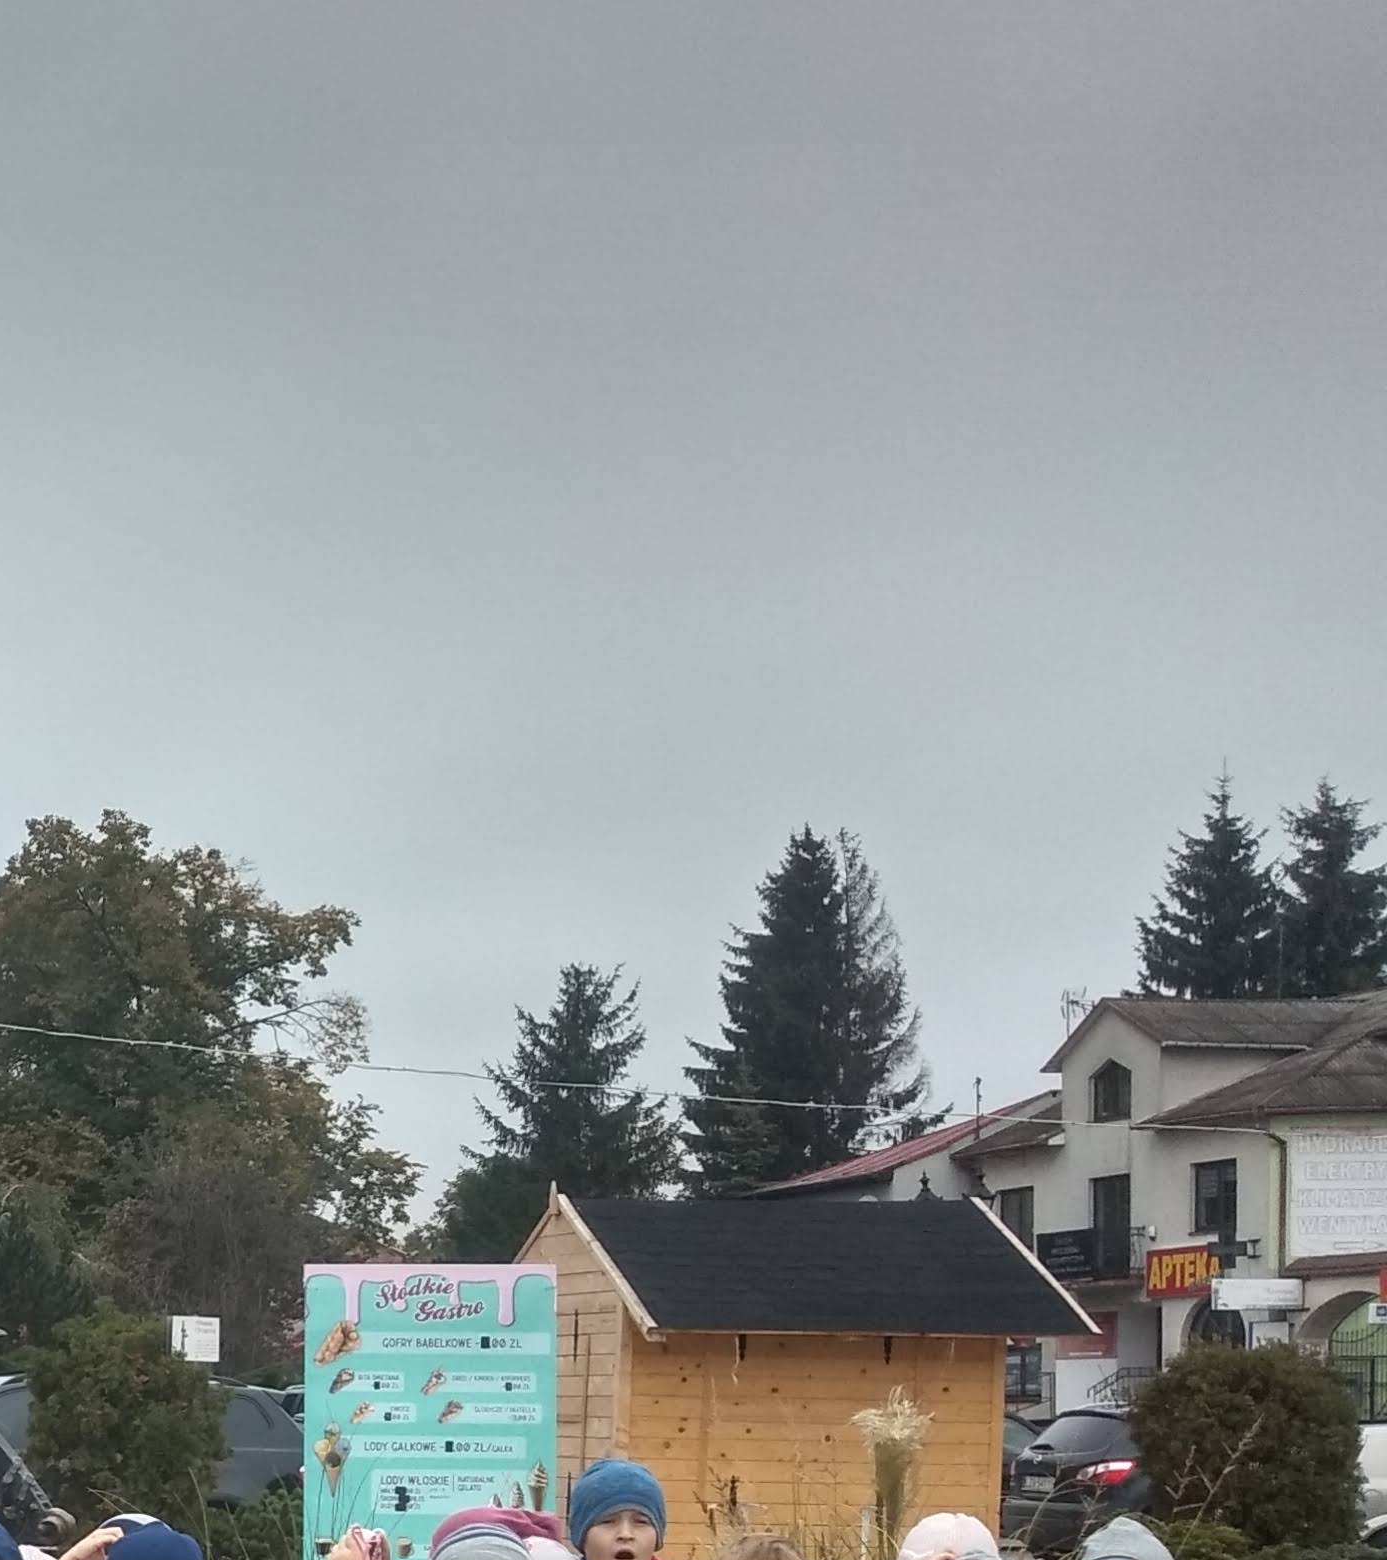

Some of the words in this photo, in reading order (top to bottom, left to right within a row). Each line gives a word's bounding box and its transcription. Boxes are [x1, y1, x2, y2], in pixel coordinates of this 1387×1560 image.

[1148, 1252, 1220, 1290] APTEKA
[375, 1276, 455, 1309] Słodkie
[414, 1299, 485, 1322] Gastro
[382, 1337, 413, 1349] GOFRY
[364, 1441, 389, 1452] LODY
[380, 1475, 405, 1486] LODY
